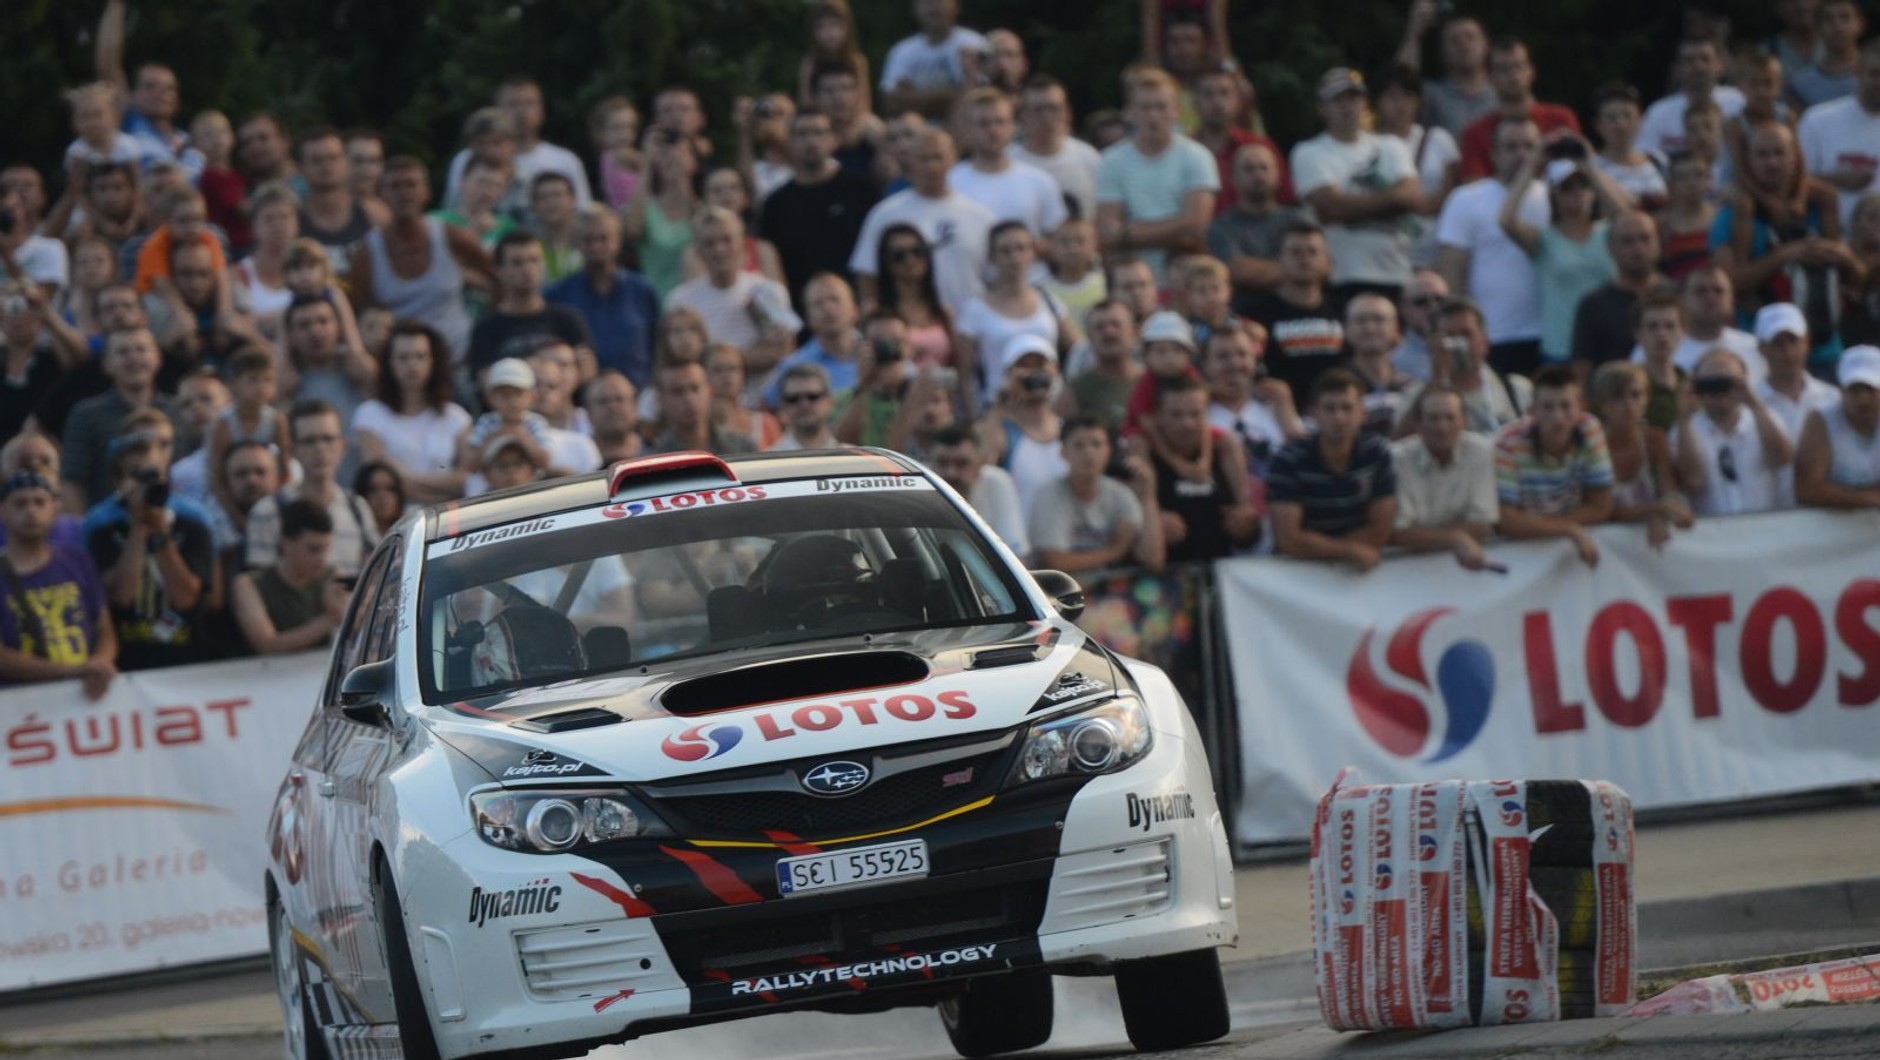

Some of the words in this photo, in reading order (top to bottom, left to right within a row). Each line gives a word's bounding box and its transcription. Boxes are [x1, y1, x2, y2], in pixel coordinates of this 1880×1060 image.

[650, 486, 768, 511] LOTOS
[816, 476, 917, 492] Dynamic
[450, 519, 556, 552] Dynamic
[1523, 578, 1880, 735] LOTOS
[754, 690, 977, 741] LOTOS
[504, 761, 584, 777] kajto.pl
[1126, 792, 1195, 832] Dynamic
[793, 859, 837, 887] SCI
[850, 846, 924, 879] 55525
[1340, 809, 1354, 884] LOTOS
[58, 850, 208, 893] Galeria
[468, 885, 562, 928] Dynamic
[731, 944, 997, 995] RALLYTECHNOLOGY
[1503, 989, 1529, 1020] OS
